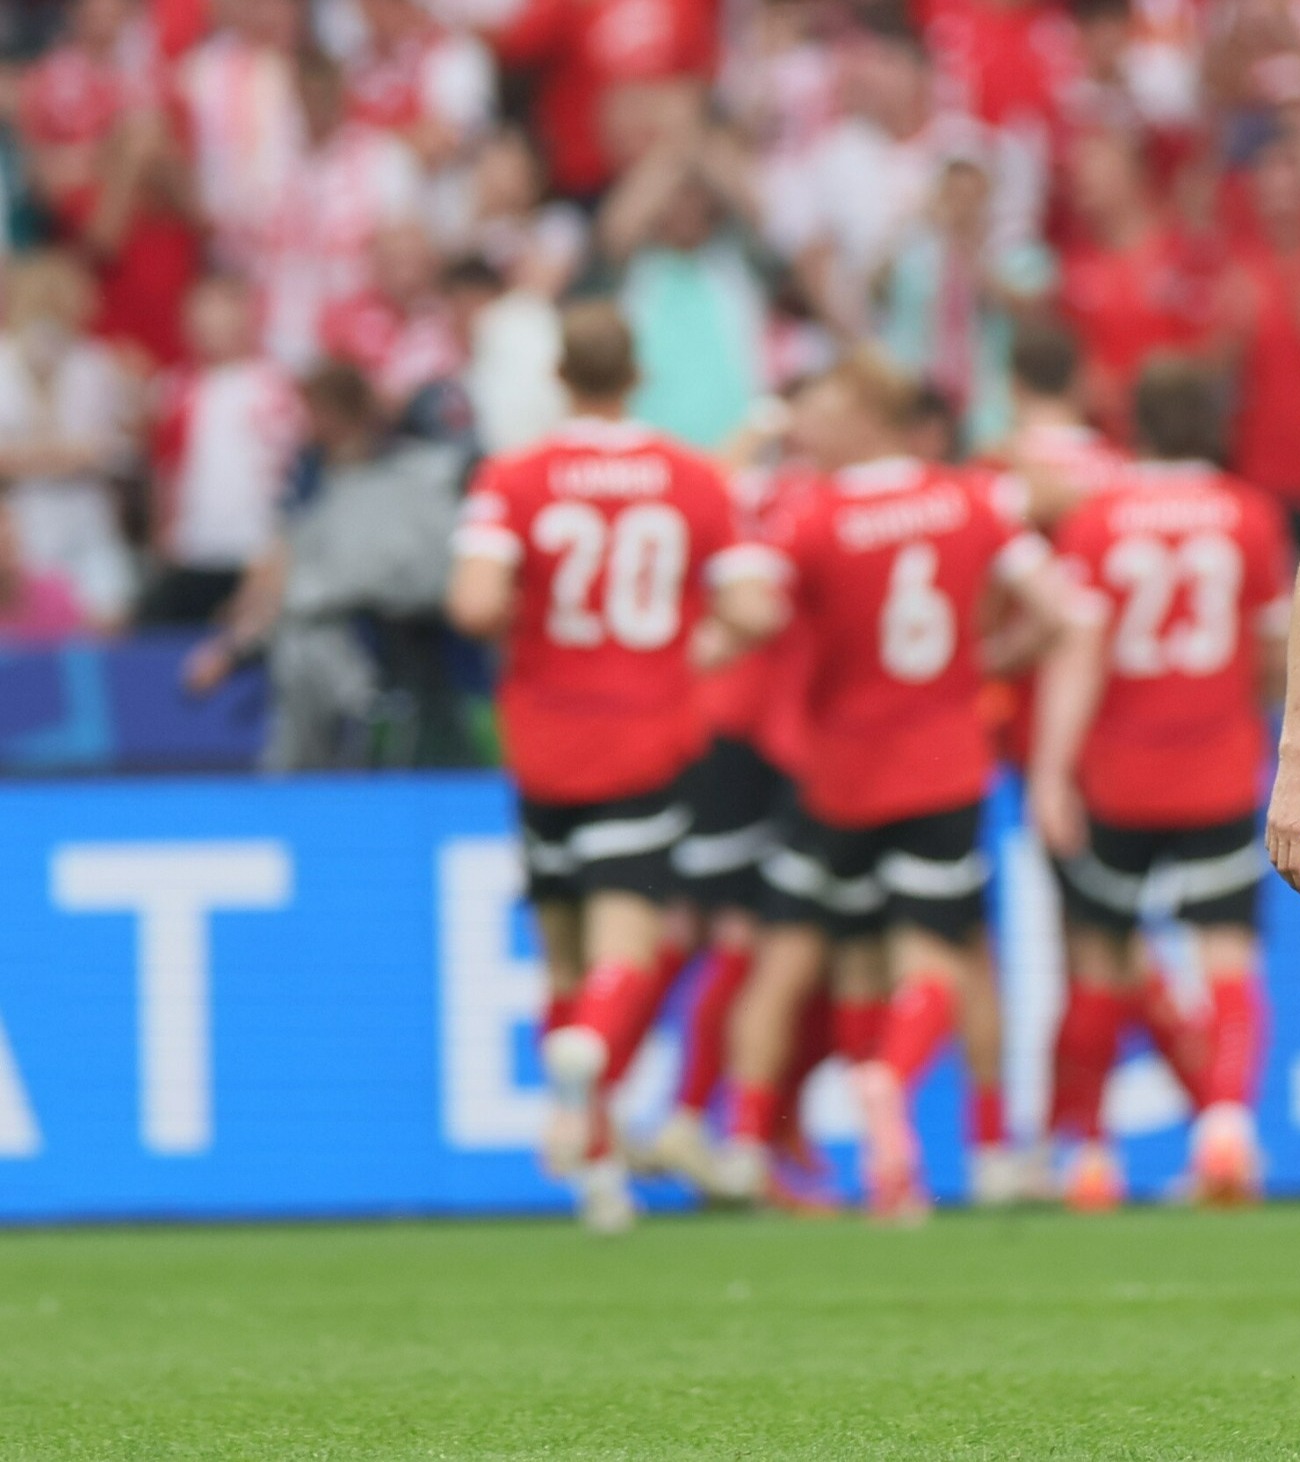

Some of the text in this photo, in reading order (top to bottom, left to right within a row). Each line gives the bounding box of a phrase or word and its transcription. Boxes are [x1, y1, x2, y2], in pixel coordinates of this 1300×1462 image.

[531, 498, 690, 651] 20
[877, 540, 957, 684] 6
[1104, 532, 1245, 677] 23
